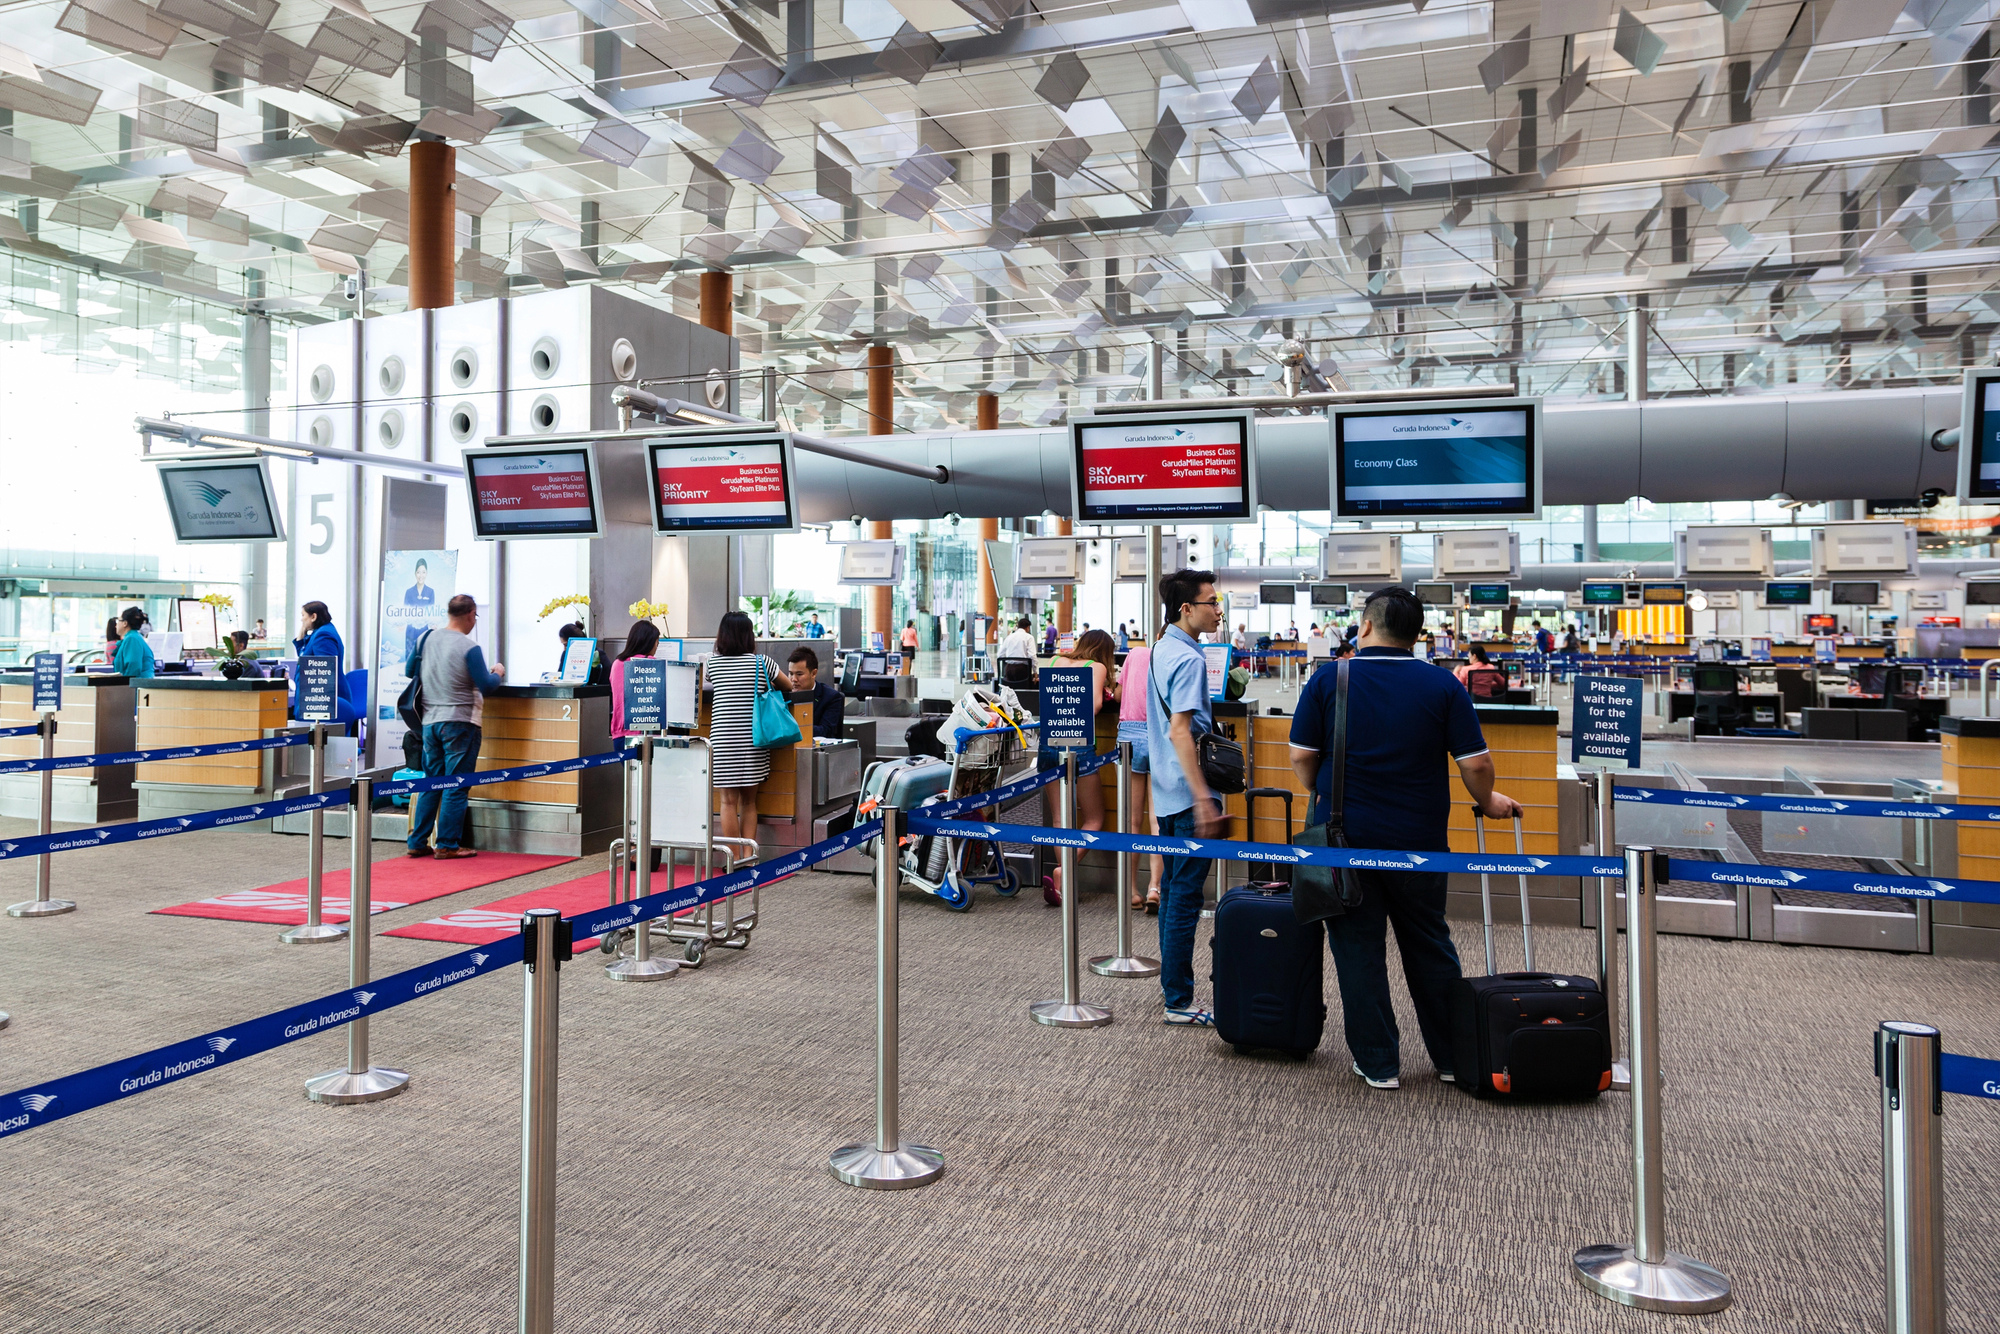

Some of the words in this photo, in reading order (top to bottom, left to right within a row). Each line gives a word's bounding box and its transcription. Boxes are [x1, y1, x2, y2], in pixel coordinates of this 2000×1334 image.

[1355, 459, 1393, 468] Economy
[1396, 458, 1417, 467] Class
[1089, 467, 1112, 475] SKY
[1173, 469, 1203, 477] SkyTeam
[1089, 475, 1144, 484] PRIORITY
[664, 483, 682, 491] SKY
[664, 491, 708, 499] PRIORITY
[482, 497, 521, 505] PRIORITY
[212, 511, 241, 519] Indonesia
[310, 493, 334, 554] 5
[1052, 674, 1079, 682] Please
[1046, 685, 1063, 693] wait
[1591, 682, 1626, 692] Please
[144, 694, 149, 706] 1
[1051, 696, 1063, 704] for
[1067, 696, 1080, 704] the
[1583, 695, 1605, 703] wait
[1609, 695, 1633, 705] here
[563, 705, 572, 720] 2
[1589, 707, 1604, 716] for
[1608, 708, 1625, 717] the
[1048, 718, 1085, 726] available
[1595, 721, 1618, 730] next
[1583, 733, 1630, 743] available
[1586, 746, 1626, 755] counter
[1614, 792, 1642, 801] Indonesia
[285, 804, 300, 813] Garuda
[301, 801, 321, 810] Indonesia
[1684, 798, 1705, 806] Garuda
[1708, 799, 1737, 808] Indonesia
[1780, 803, 1805, 812] Garuda
[1807, 805, 1836, 813] Indonesia
[216, 816, 233, 824] Garuda
[234, 813, 256, 821] Indonesia
[1882, 809, 1906, 817] Garuda
[1908, 810, 1940, 818] Indonesia
[138, 829, 157, 837] Garuda
[158, 826, 182, 834] Indonesia
[937, 826, 958, 836] Garuda
[960, 828, 988, 838] Indonesia
[49, 841, 71, 850] Garuda
[72, 838, 99, 847] Indonesia
[1032, 834, 1054, 844] Garuda
[1056, 836, 1086, 846] Indonesia
[1132, 843, 1155, 852] Garuda
[1158, 844, 1189, 854] Indonesia
[1238, 850, 1262, 860] Garuda
[1264, 852, 1298, 862] Indonesia
[788, 861, 802, 871] Indonesia
[1349, 857, 1375, 867] Garuda
[1378, 858, 1413, 869] Indonesia
[1467, 863, 1496, 873] Garuda
[1498, 863, 1535, 873] Indonesia
[1592, 866, 1623, 876] Garuda
[1712, 872, 1743, 883] Garuda
[1746, 875, 1788, 887] Indonesia
[724, 885, 736, 894] Garuda
[737, 879, 754, 889] Indonesia
[1854, 883, 1888, 894] Garuda
[1890, 884, 1935, 897] Indonesia
[663, 902, 678, 911] Garuda
[679, 897, 698, 907] Indonesia
[592, 920, 609, 932] Garuda
[611, 915, 632, 927] Indonesia
[415, 977, 441, 993] Garuda
[443, 966, 475, 984] Indonesia
[285, 1018, 317, 1038] Garuda
[320, 1005, 359, 1025] Indonesia
[120, 1071, 161, 1093] Garuda
[165, 1053, 215, 1078] Indonesia
